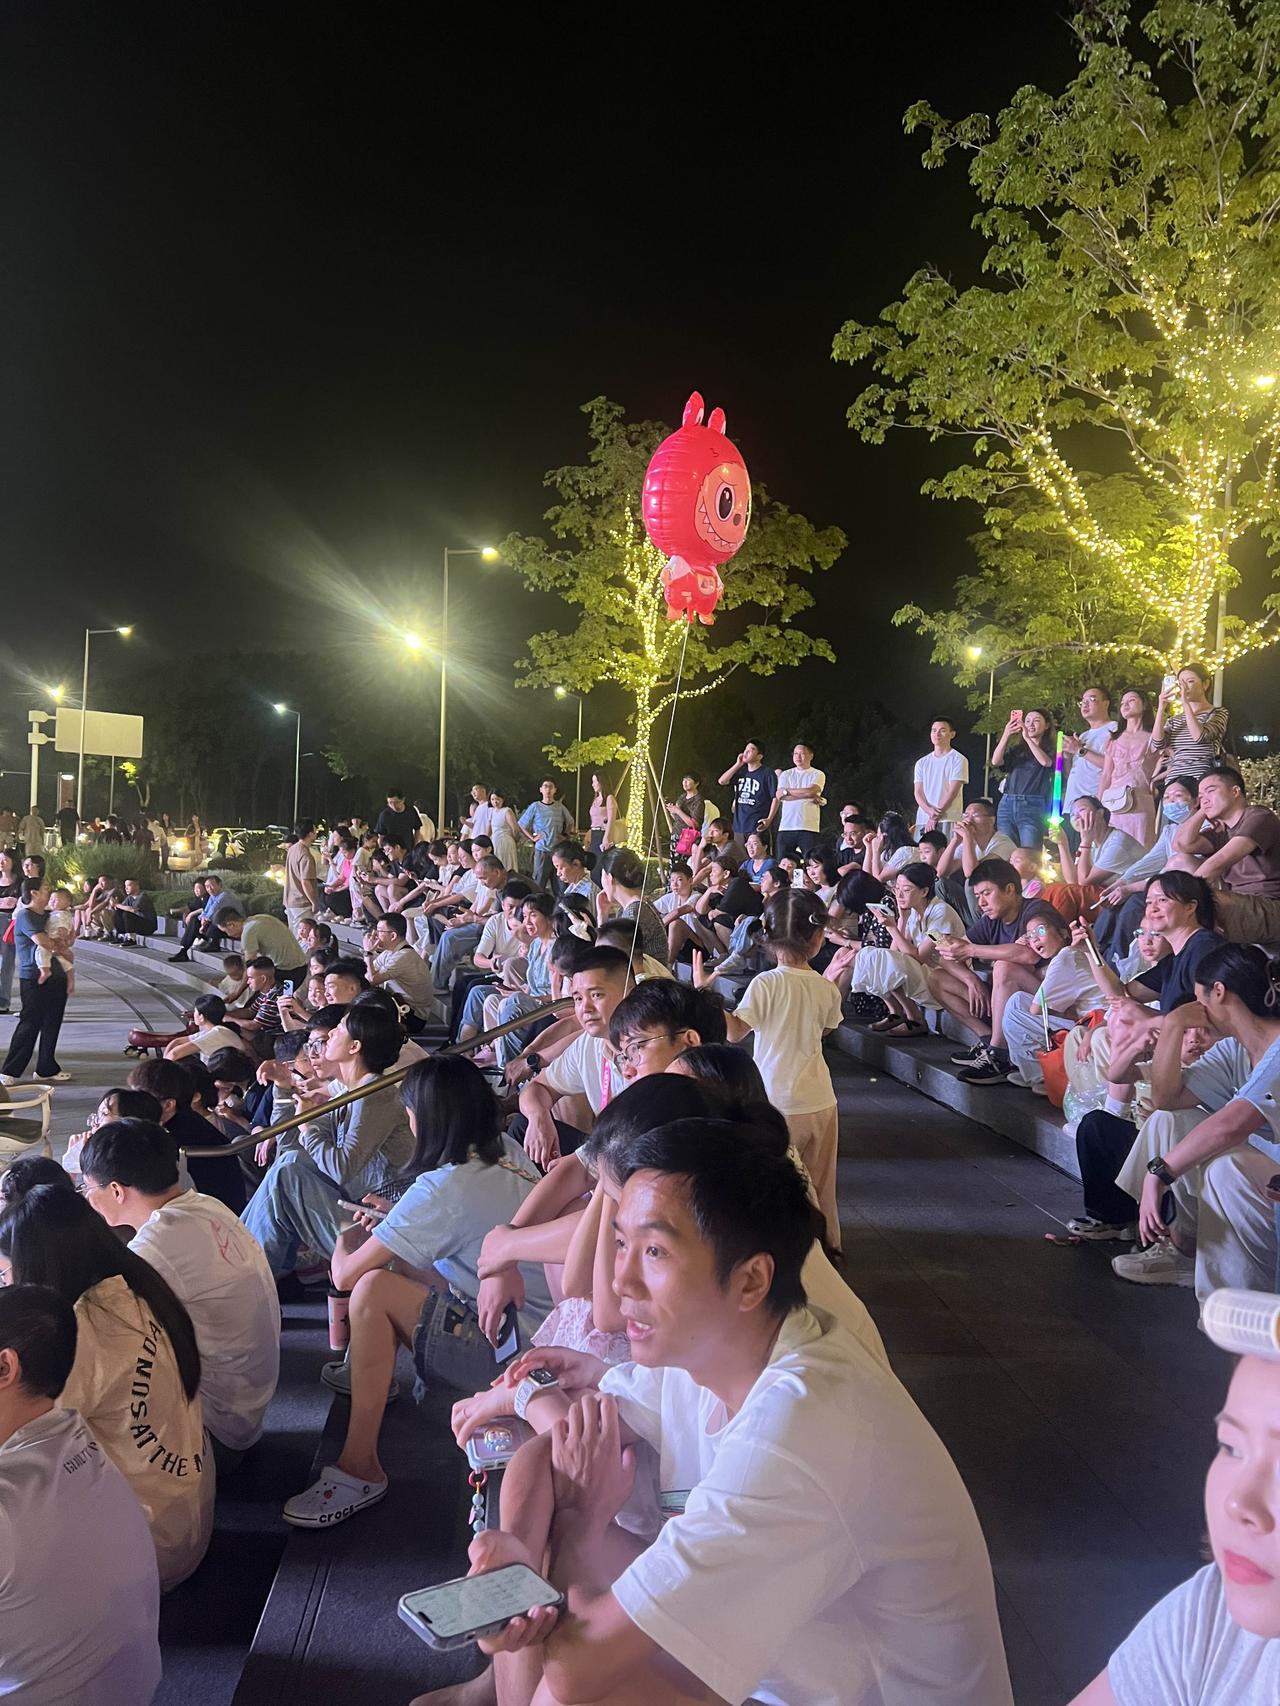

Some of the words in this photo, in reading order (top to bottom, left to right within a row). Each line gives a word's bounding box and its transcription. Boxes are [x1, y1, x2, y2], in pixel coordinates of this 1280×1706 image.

[130, 1319, 162, 1421] SUNDA
[148, 1445, 189, 1477] THE
[319, 1504, 354, 1523] crocs
